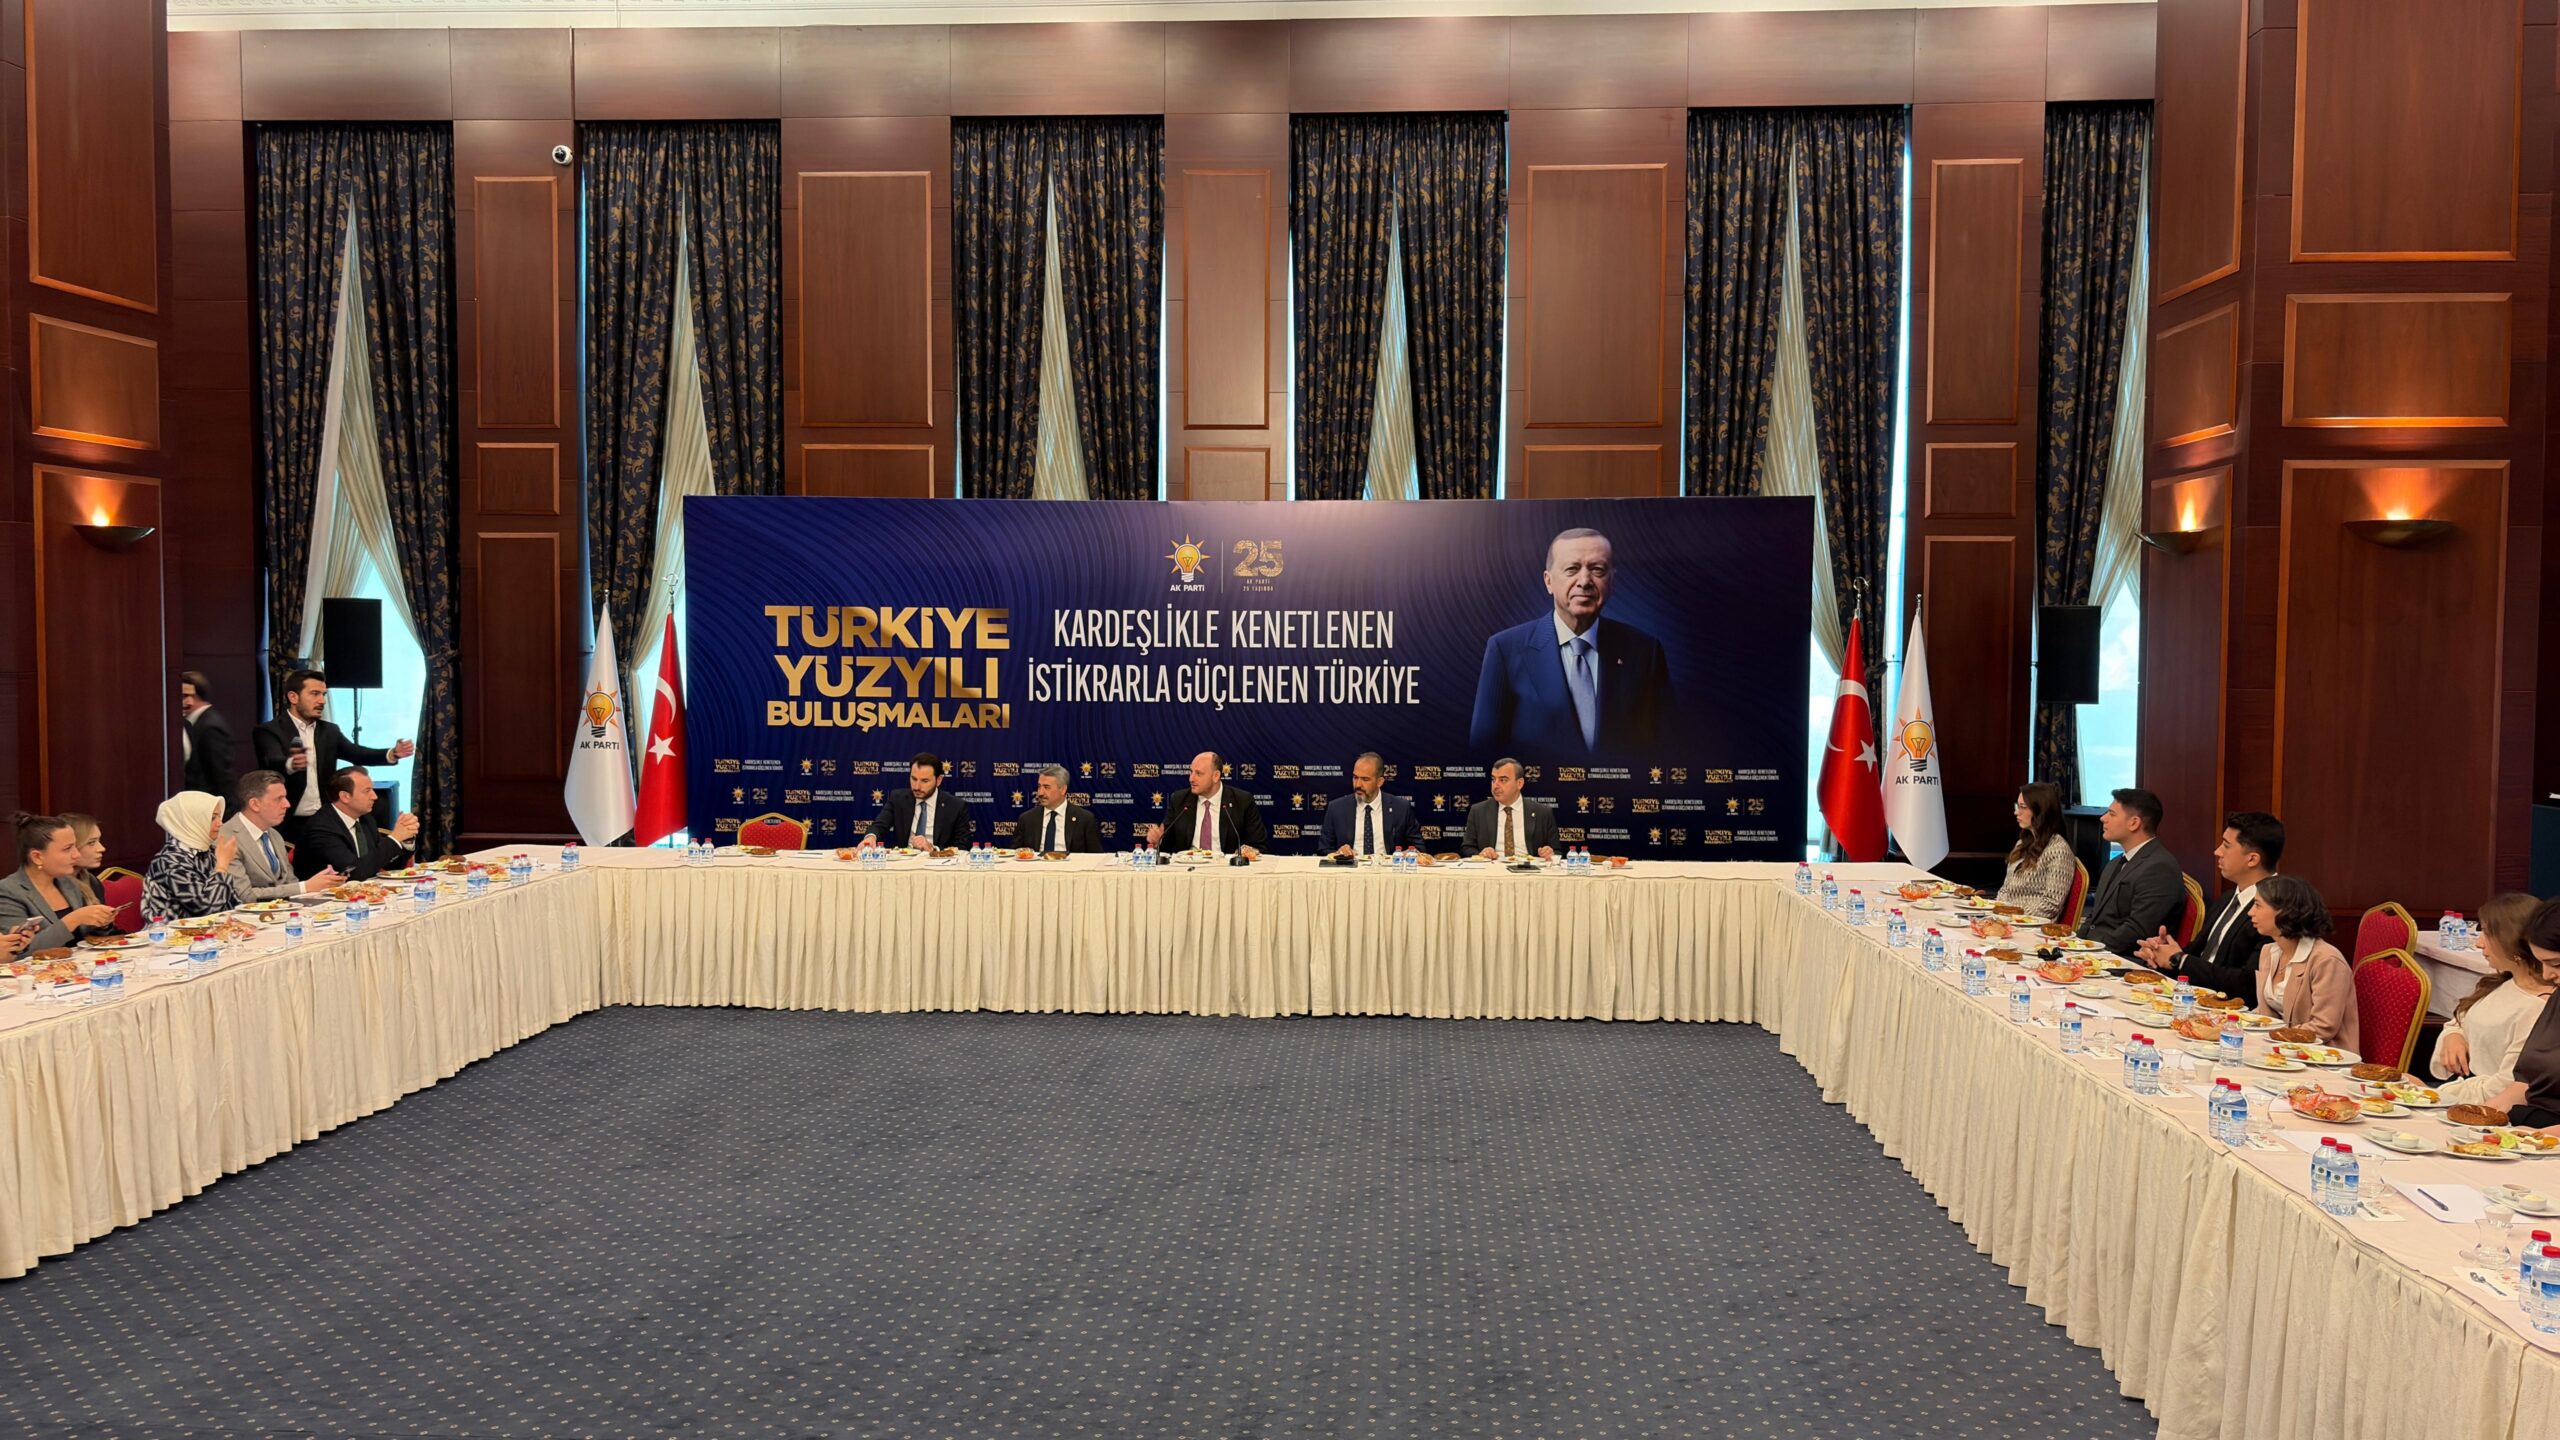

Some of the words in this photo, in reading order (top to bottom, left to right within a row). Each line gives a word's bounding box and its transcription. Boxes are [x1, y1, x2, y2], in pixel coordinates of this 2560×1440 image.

[1232, 539, 1284, 577] 25
[1169, 584, 1181, 592] AK
[1183, 584, 1205, 592] PARTİ
[764, 605, 1010, 650] TÜRKİYE
[1054, 603, 1220, 656] KARDEŞLİKLE
[1231, 610, 1394, 649] KENETLENEN
[773, 654, 999, 699] YÜZYILI
[1028, 657, 1171, 703] İSTİKRARLA
[1177, 657, 1309, 711] GÜÇLENEN
[1314, 658, 1421, 704] TÜRKİYE
[766, 700, 1010, 733] BULUŞMALARI
[580, 740, 590, 750] AK
[593, 740, 620, 751] PARTİ
[1895, 775, 1908, 785] AK
[1913, 775, 1939, 787] PARTİ
